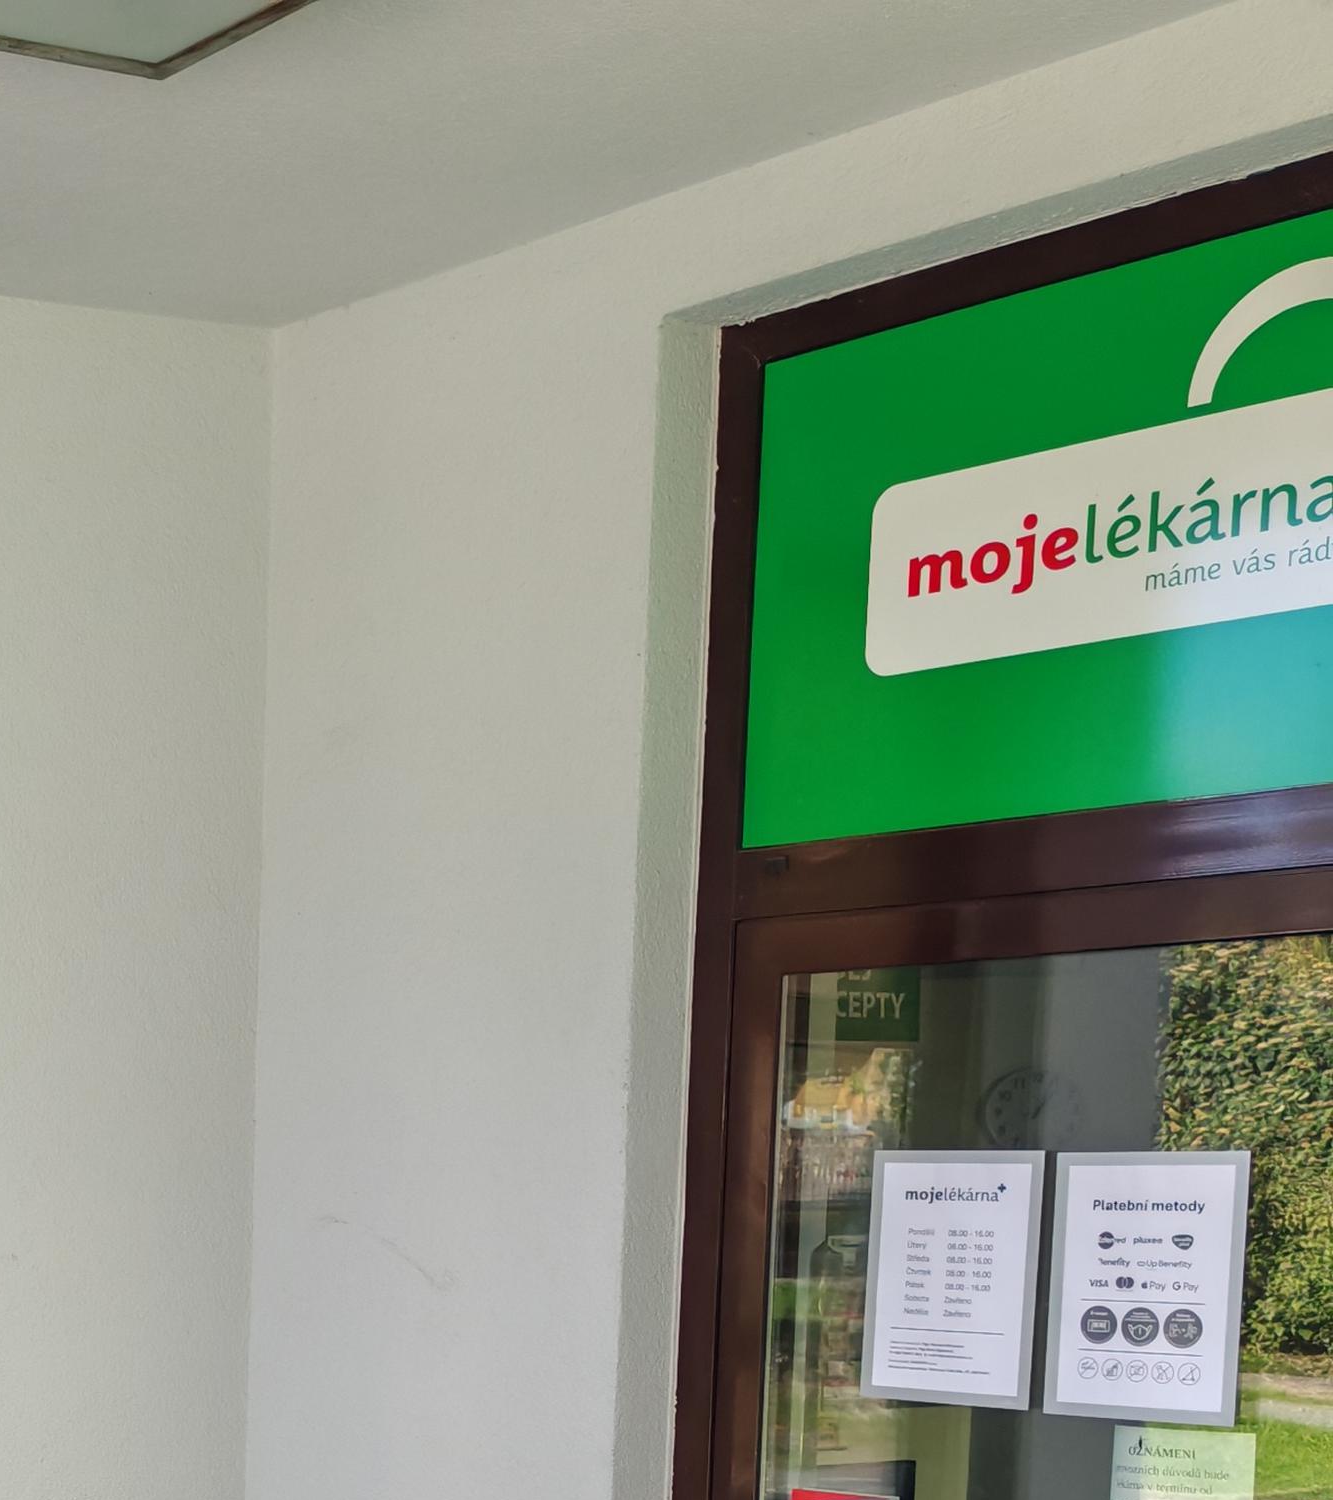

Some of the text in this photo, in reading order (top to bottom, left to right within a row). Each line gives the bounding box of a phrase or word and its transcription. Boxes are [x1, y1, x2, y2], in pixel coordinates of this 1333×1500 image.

[907, 474, 1333, 599] mojelékárna
[1145, 535, 1333, 592] máme vás rád
[904, 1186, 1000, 1205] mojelékárna
[1092, 1198, 1206, 1215] Platební metody
[1089, 1279, 1109, 1288] VISA
[1204, 1469, 1230, 1481] bude
[1156, 1481, 1197, 1495] termínu
[1199, 1484, 1213, 1495] od
